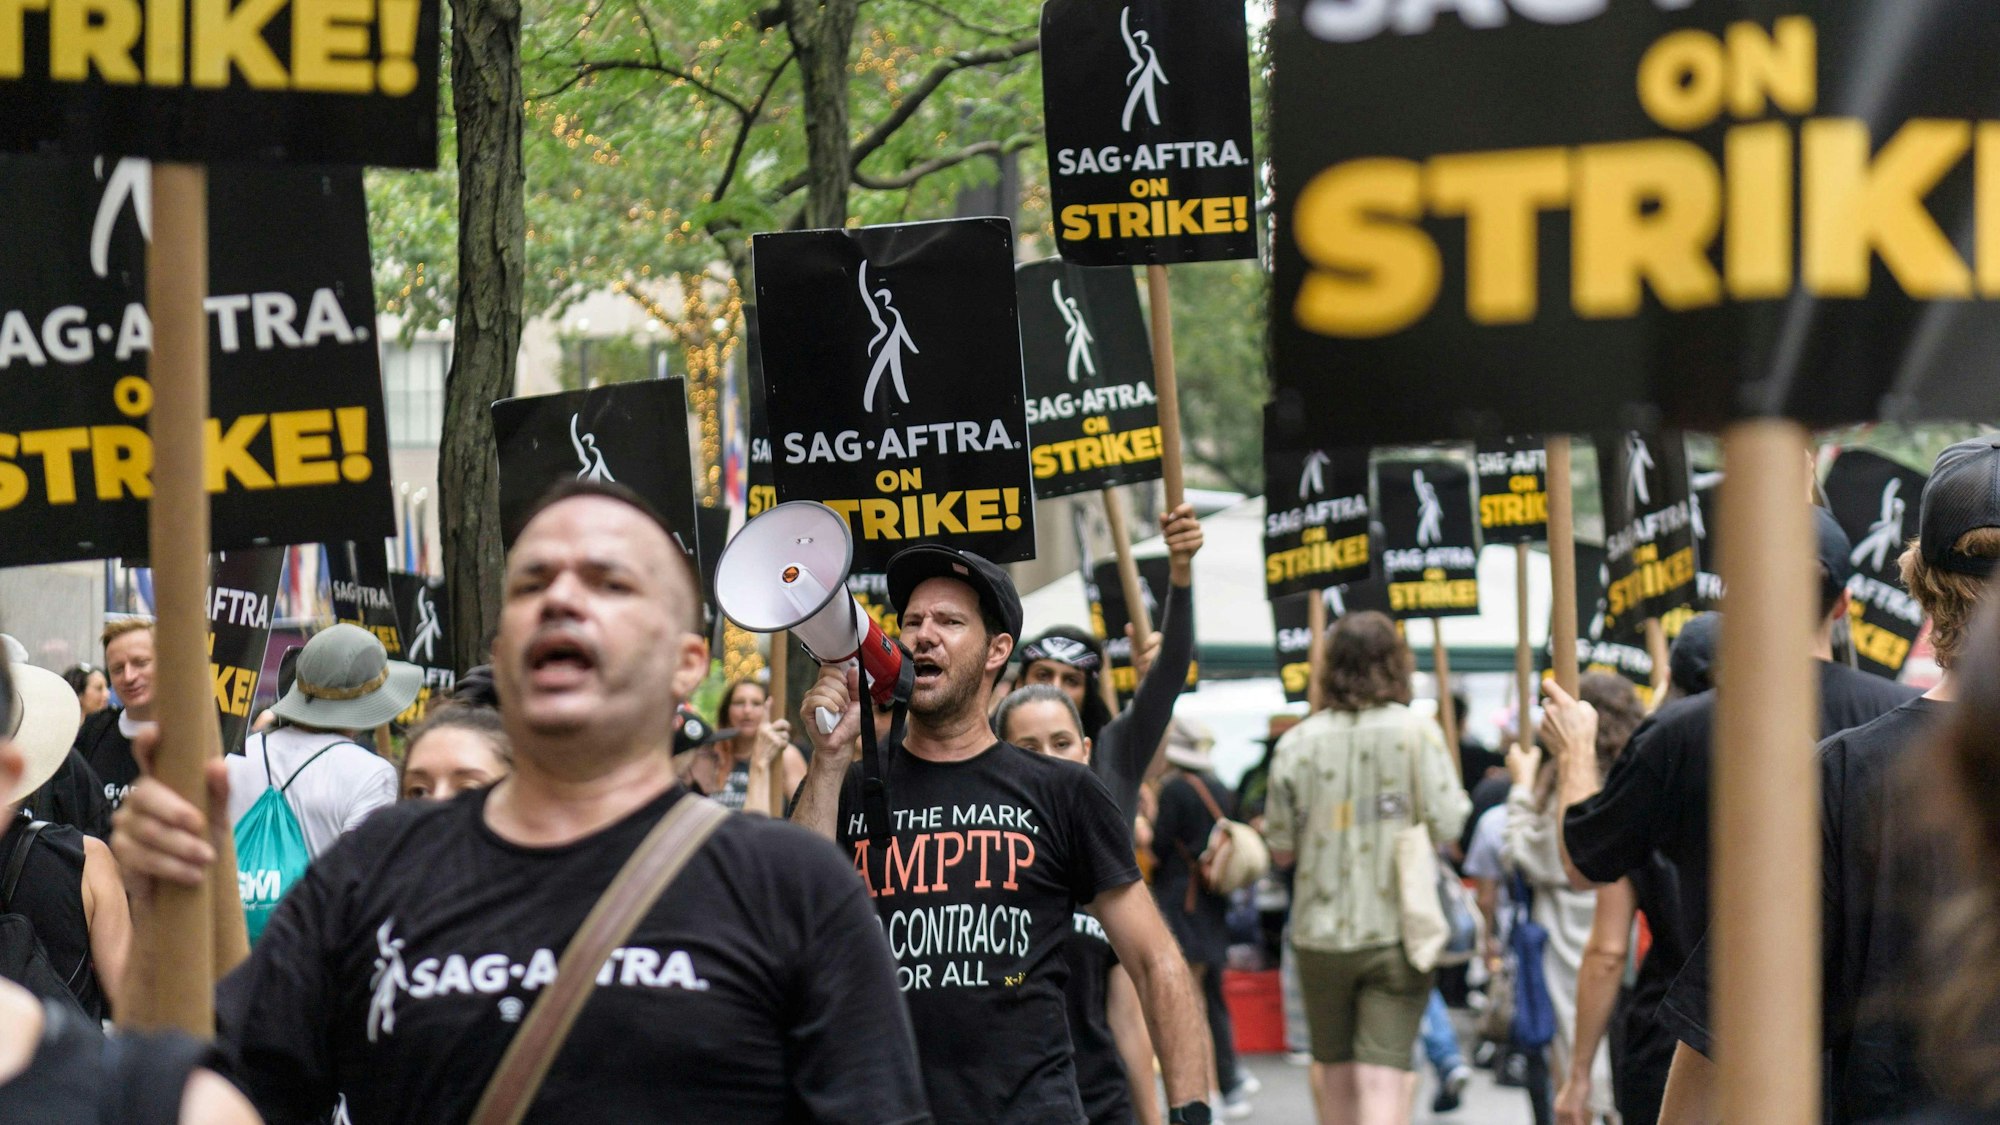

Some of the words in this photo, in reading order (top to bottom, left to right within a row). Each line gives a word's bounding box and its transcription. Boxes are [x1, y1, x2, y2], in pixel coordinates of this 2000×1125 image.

[0, 0, 420, 97] TRIKE!
[1637, 15, 1817, 130] ON
[1129, 178, 1169, 198] ON
[1060, 196, 1249, 241] STRIKE!
[1293, 117, 2000, 338] STRIK
[113, 375, 154, 417] O
[1082, 415, 1110, 436] ON
[1031, 425, 1163, 479] STRIKE!
[875, 467, 922, 493] ON
[822, 487, 1022, 540] TRIKE!
[893, 806, 943, 830] THE
[952, 804, 1040, 835] MARK,
[853, 829, 1036, 898] AMPTP
[889, 903, 1032, 960] CONTRACTS
[896, 963, 932, 992] OR
[940, 960, 990, 988] ALL
